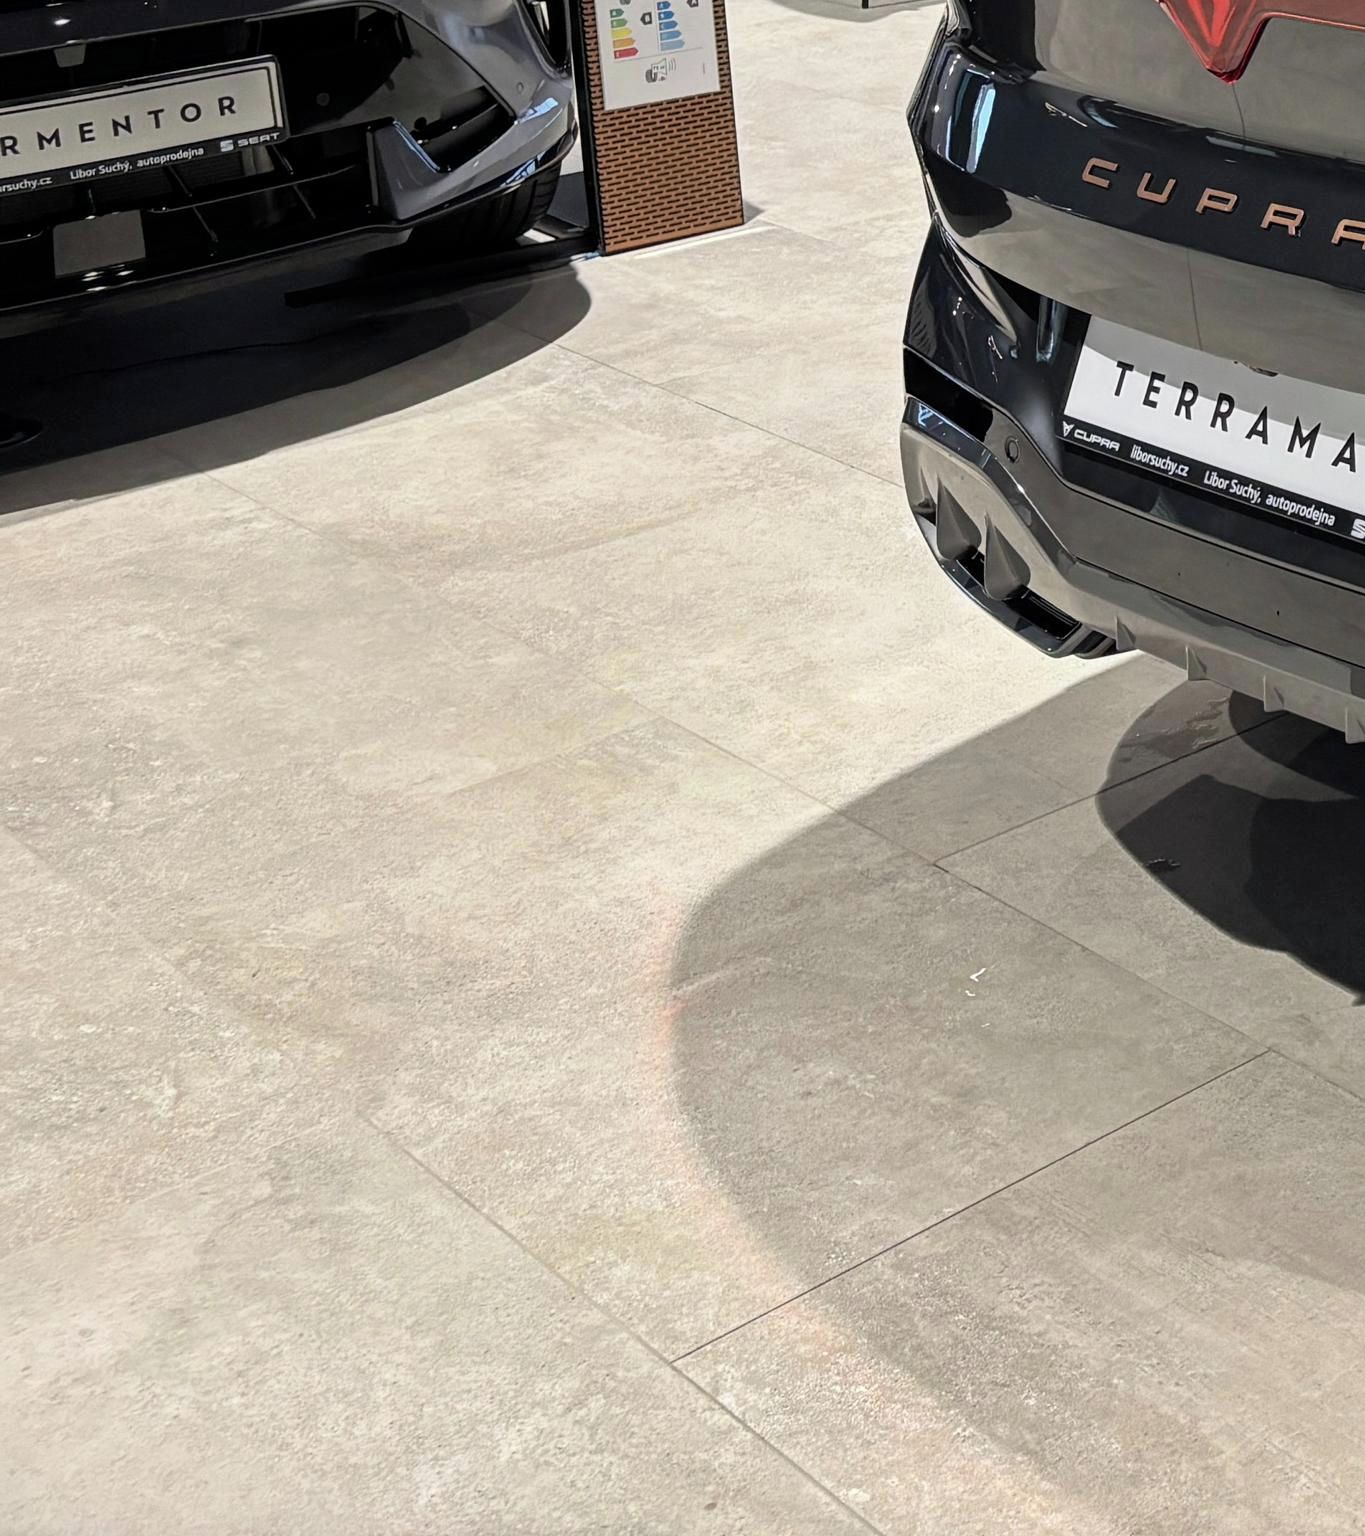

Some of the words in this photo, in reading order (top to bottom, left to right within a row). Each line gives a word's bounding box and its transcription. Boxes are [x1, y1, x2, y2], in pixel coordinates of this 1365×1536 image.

[237, 131, 281, 146] SEAT
[70, 167, 97, 180] Libor
[136, 146, 205, 168] autoprodejna
[1073, 429, 1121, 452] CUPRA
[1130, 444, 1190, 477] liborsuchy.cz
[1203, 470, 1230, 491] Libor
[1229, 479, 1262, 504] Suchý,
[1265, 493, 1336, 527] autoprodejna
